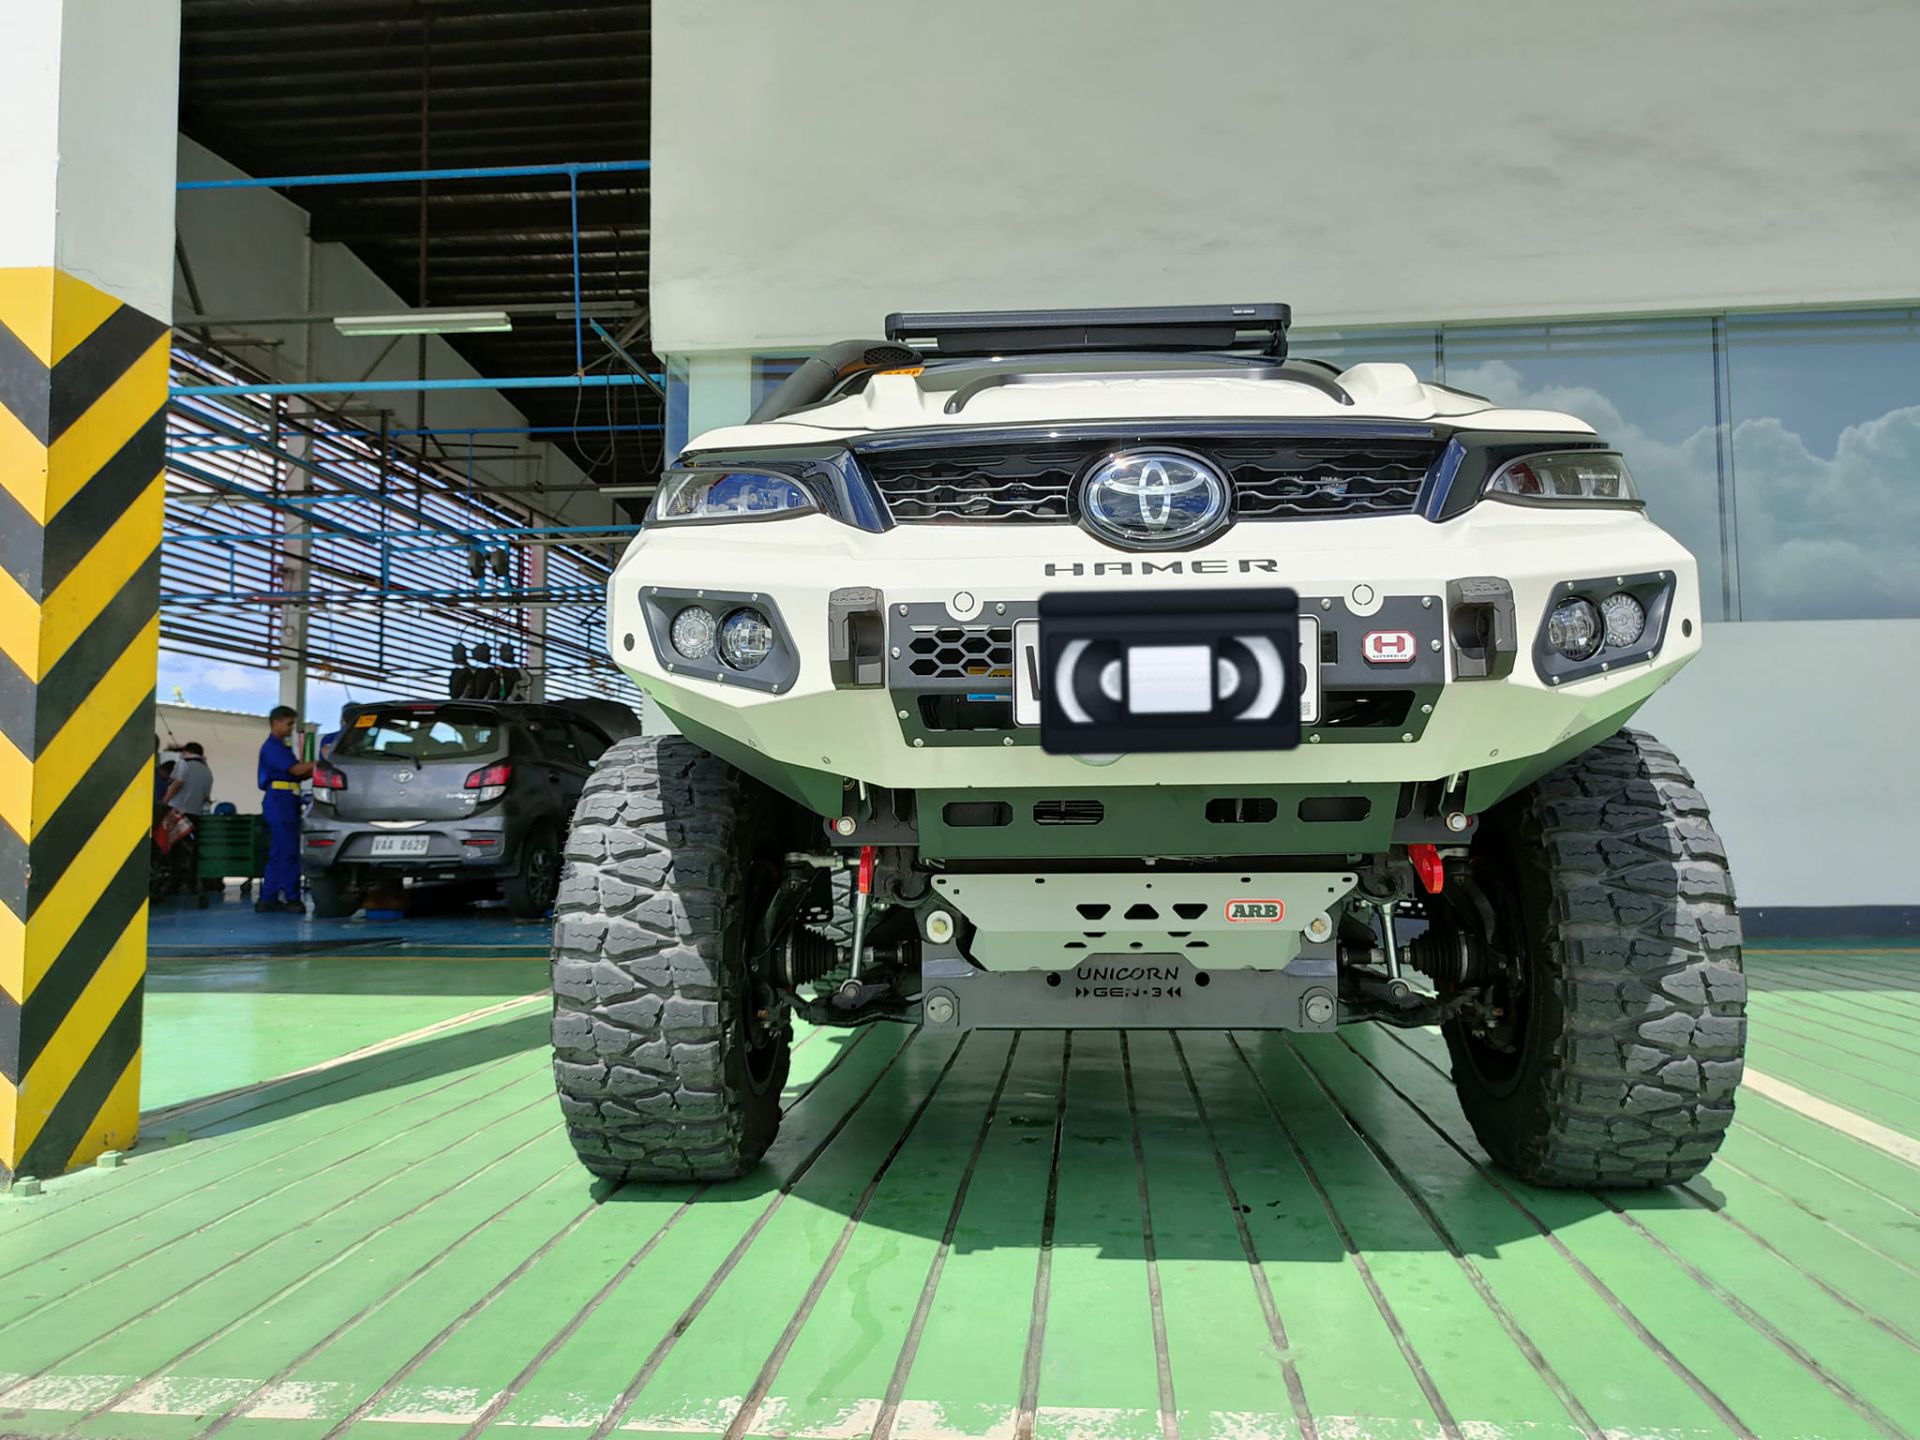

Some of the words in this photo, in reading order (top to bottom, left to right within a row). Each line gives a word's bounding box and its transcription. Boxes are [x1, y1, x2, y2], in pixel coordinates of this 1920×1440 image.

[1044, 559, 1280, 576] HAMER
[1232, 904, 1278, 918] ARB
[1077, 966, 1179, 980] UNICORN
